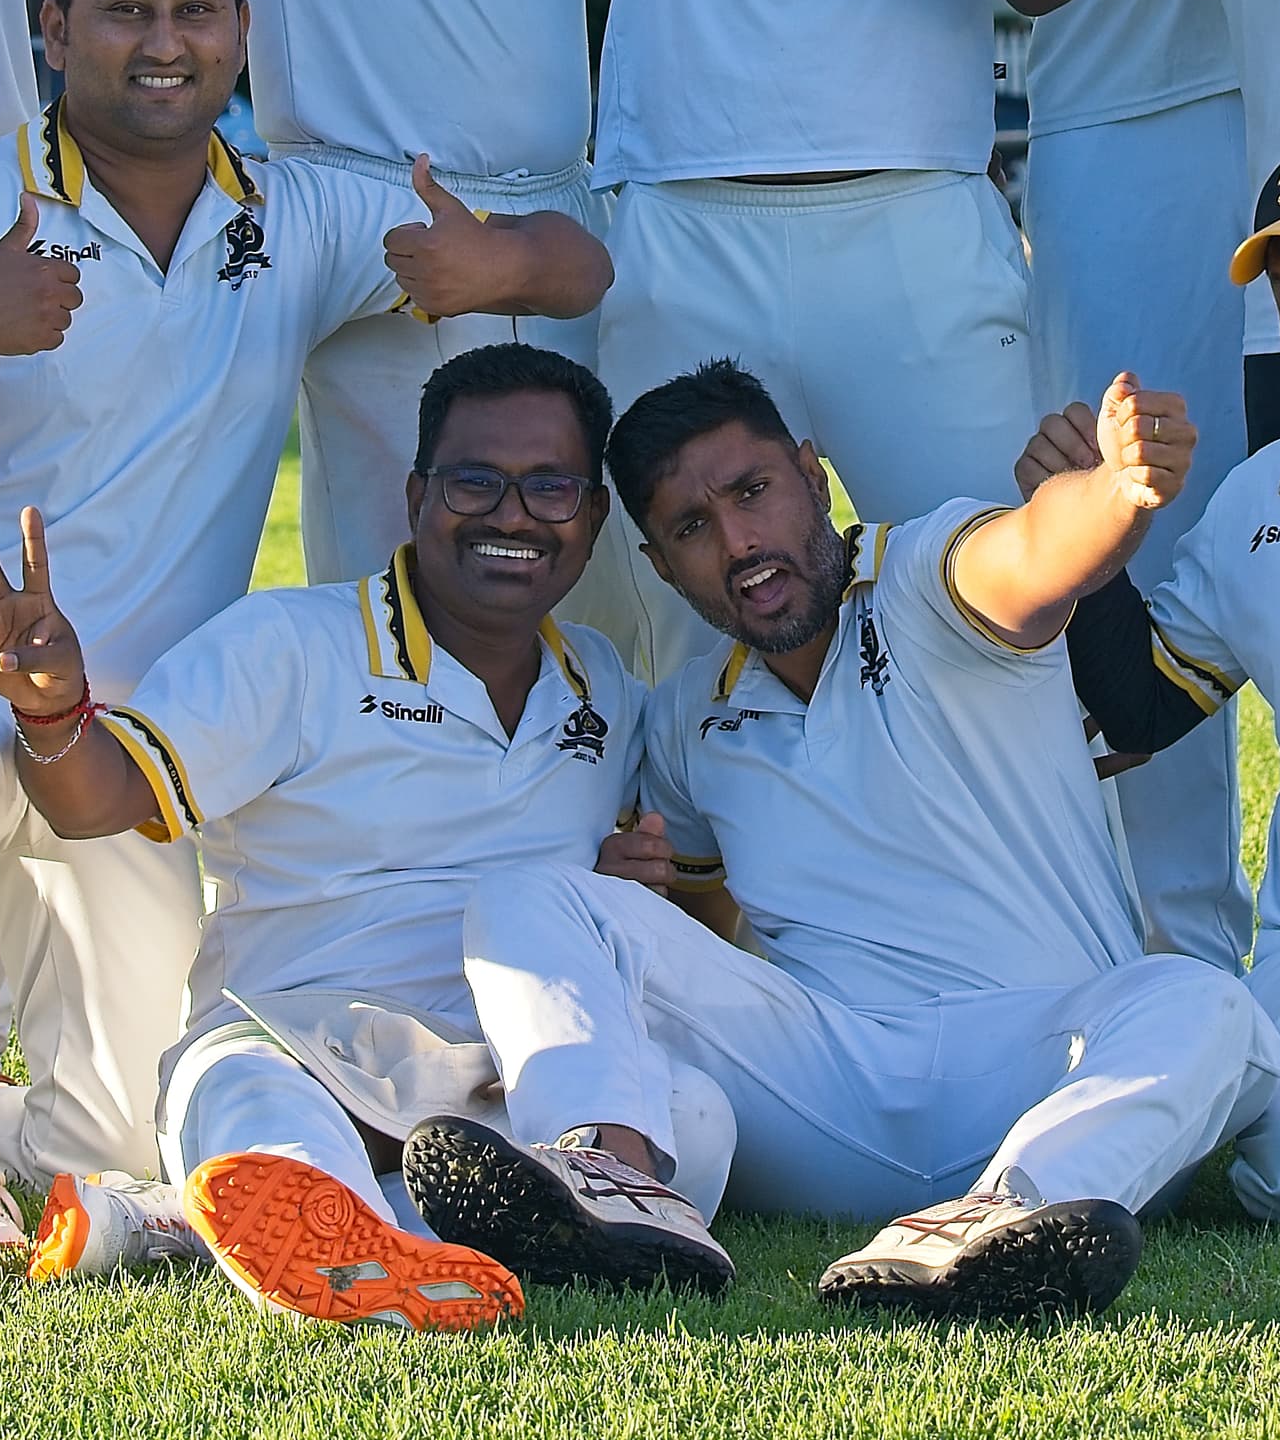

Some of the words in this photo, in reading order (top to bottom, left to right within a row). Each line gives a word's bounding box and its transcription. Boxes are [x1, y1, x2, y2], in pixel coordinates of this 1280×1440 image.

[1000, 333, 1017, 348] FLX
[380, 701, 444, 724] Sinalli
[167, 762, 183, 794] COLTS
